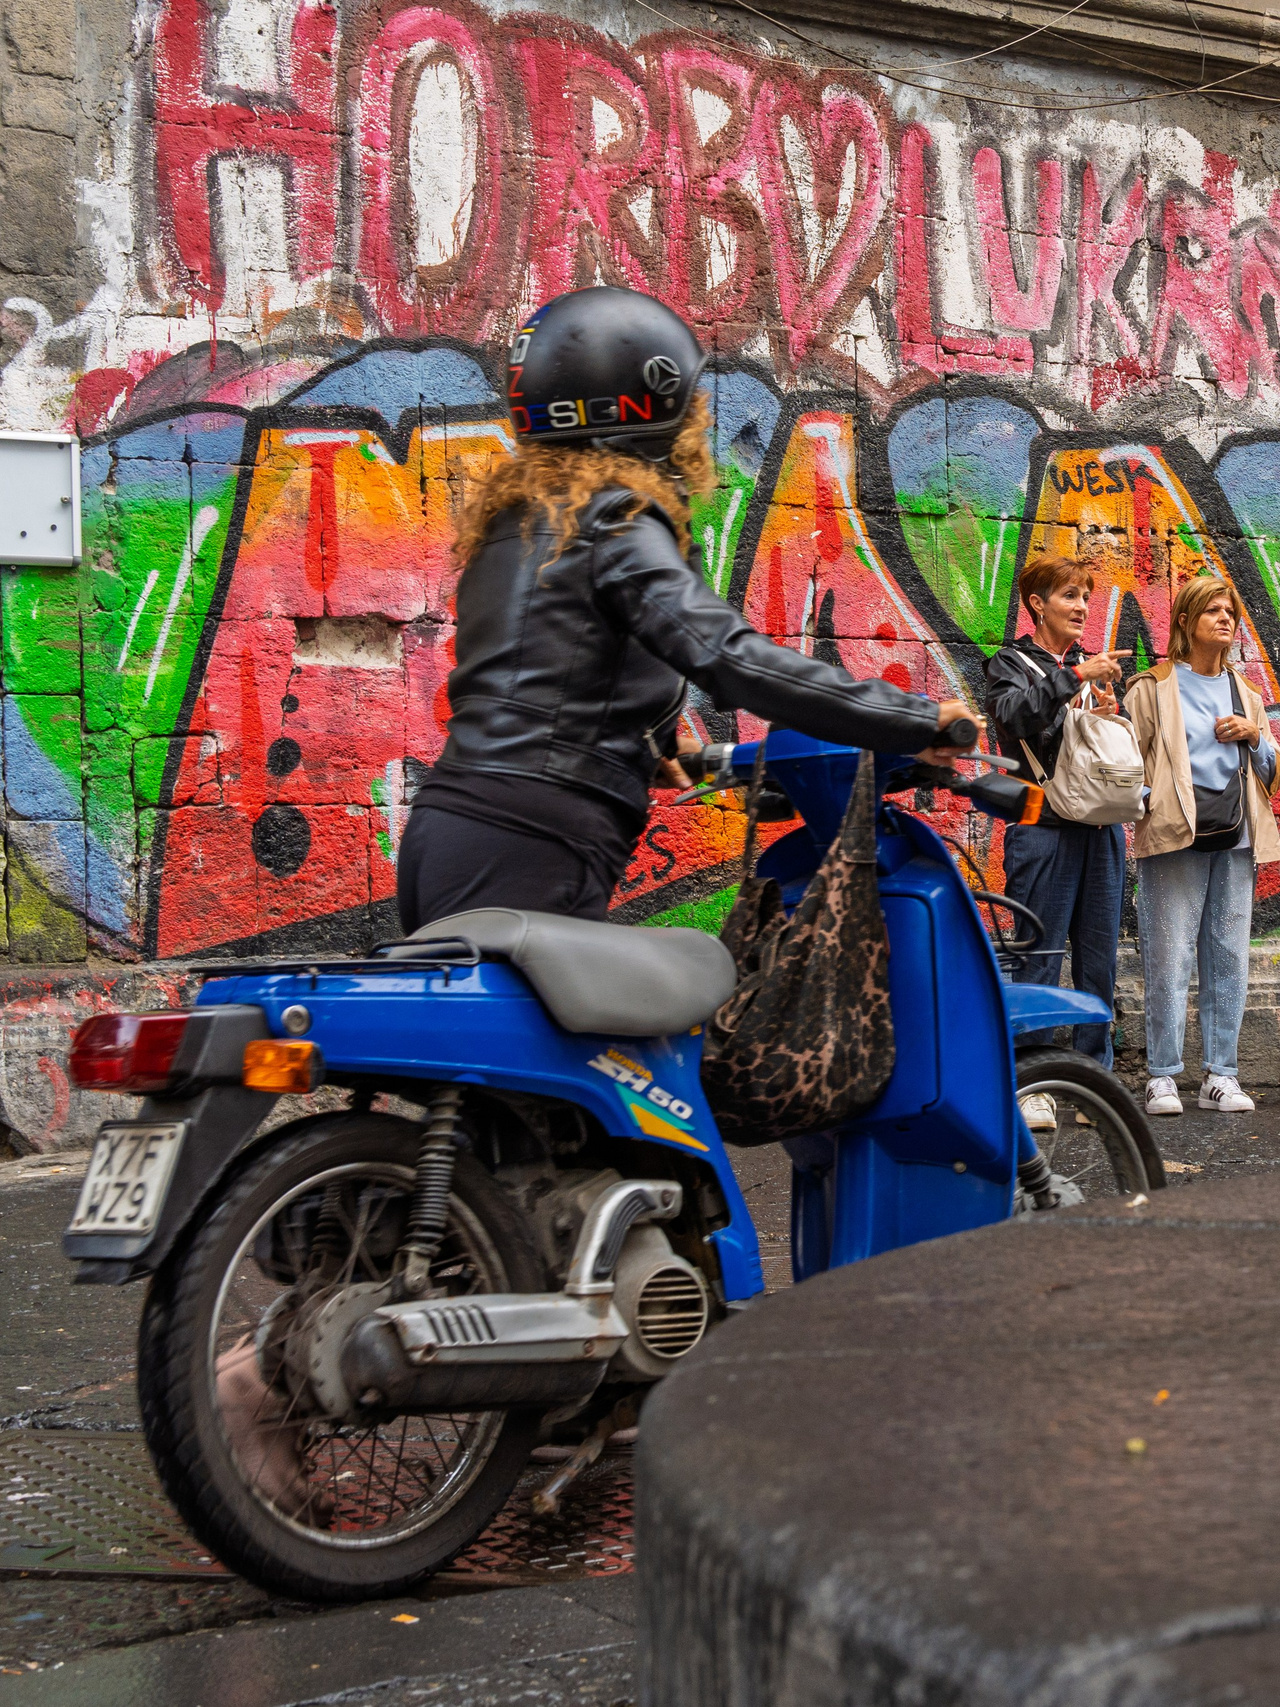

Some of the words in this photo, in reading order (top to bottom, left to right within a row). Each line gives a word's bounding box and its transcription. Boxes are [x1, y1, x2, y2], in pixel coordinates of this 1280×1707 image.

[511, 394, 653, 432] DESIGN
[606, 1049, 654, 1082] HONDA
[647, 1086, 694, 1120] 50
[97, 1134, 164, 1177] X7F
